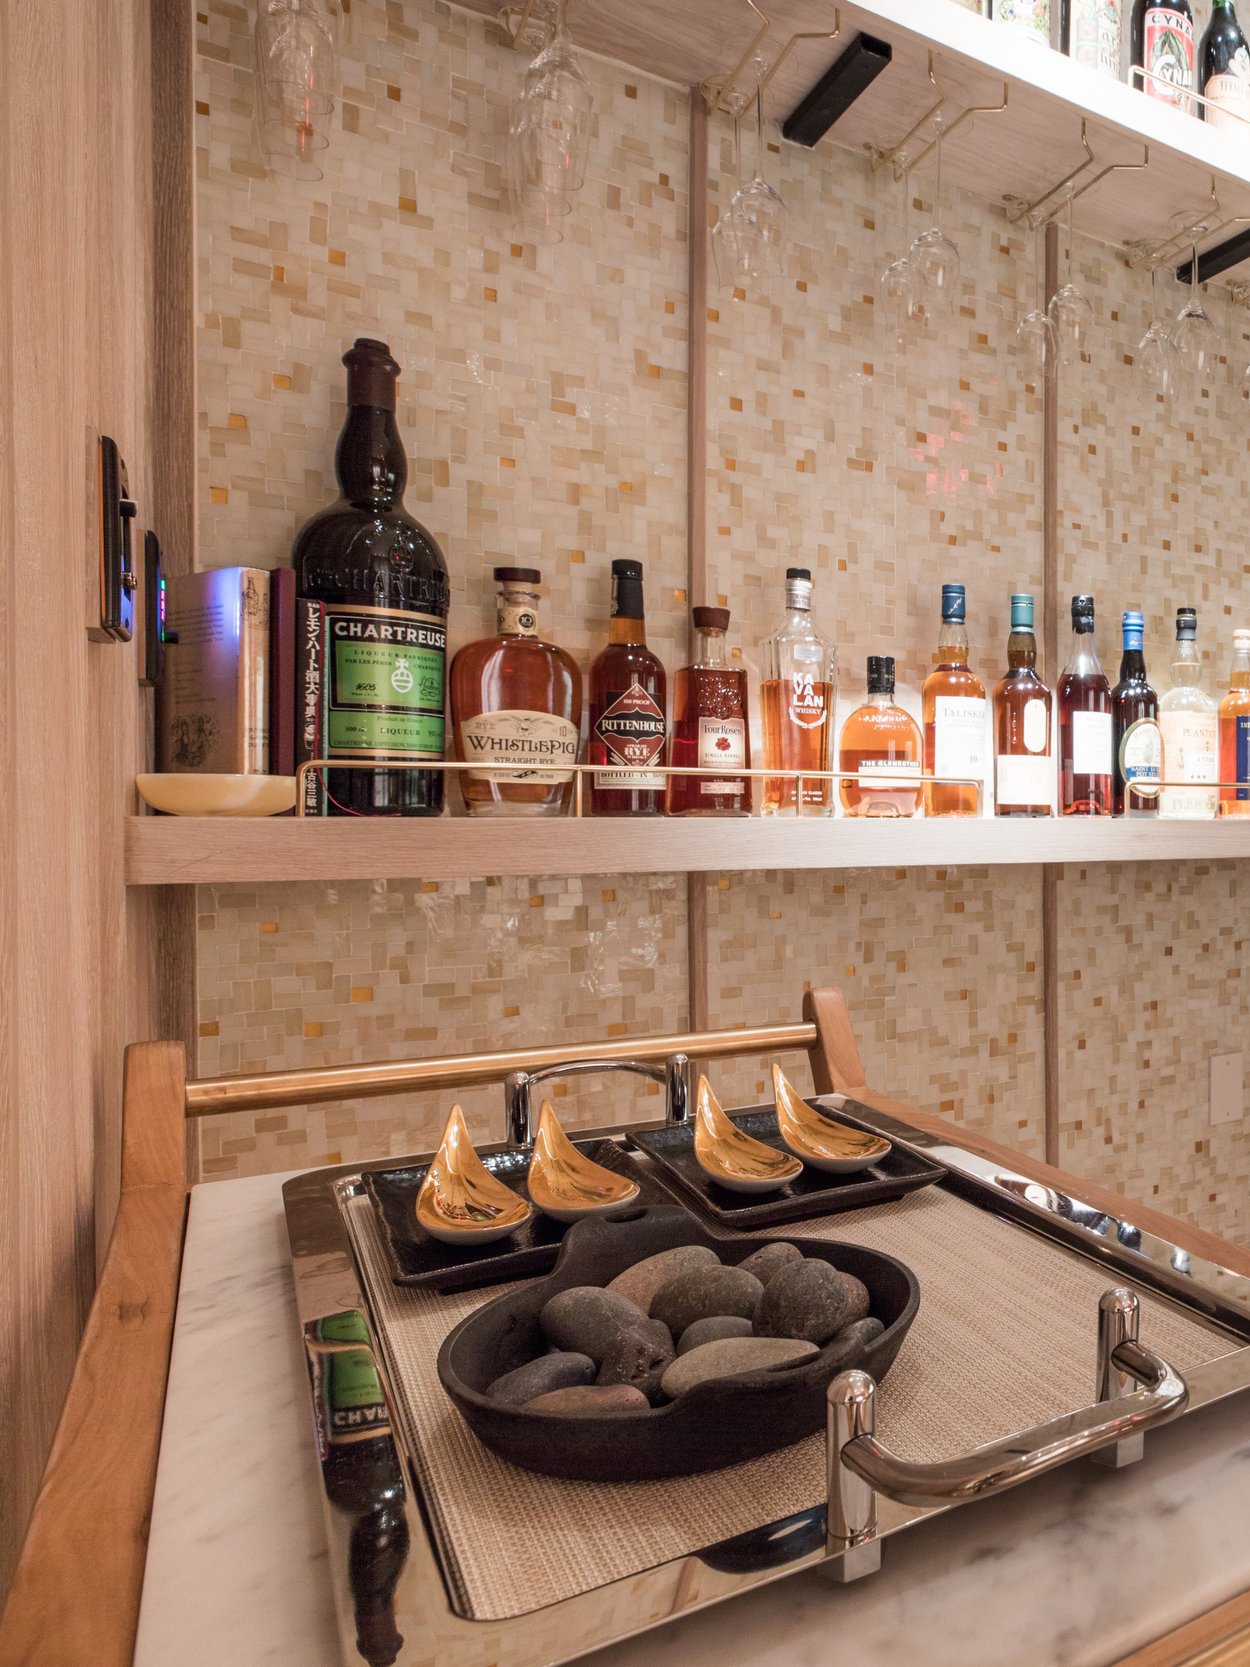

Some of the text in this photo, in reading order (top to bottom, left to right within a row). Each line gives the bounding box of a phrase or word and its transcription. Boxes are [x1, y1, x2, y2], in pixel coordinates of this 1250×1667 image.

[1151, 14, 1191, 36] CYNA
[334, 621, 446, 648] CHARTREUSE
[793, 672, 814, 685] KA
[794, 684, 814, 695] VA
[793, 695, 824, 707] LAN
[794, 706, 821, 716] WHISKY
[380, 727, 421, 736] LIQUEUR
[601, 719, 664, 733] RITTENHOUSE
[624, 747, 650, 756] RYE
[494, 756, 556, 765] STRAIGHT RYE
[877, 760, 920, 768] GLENROTHES
